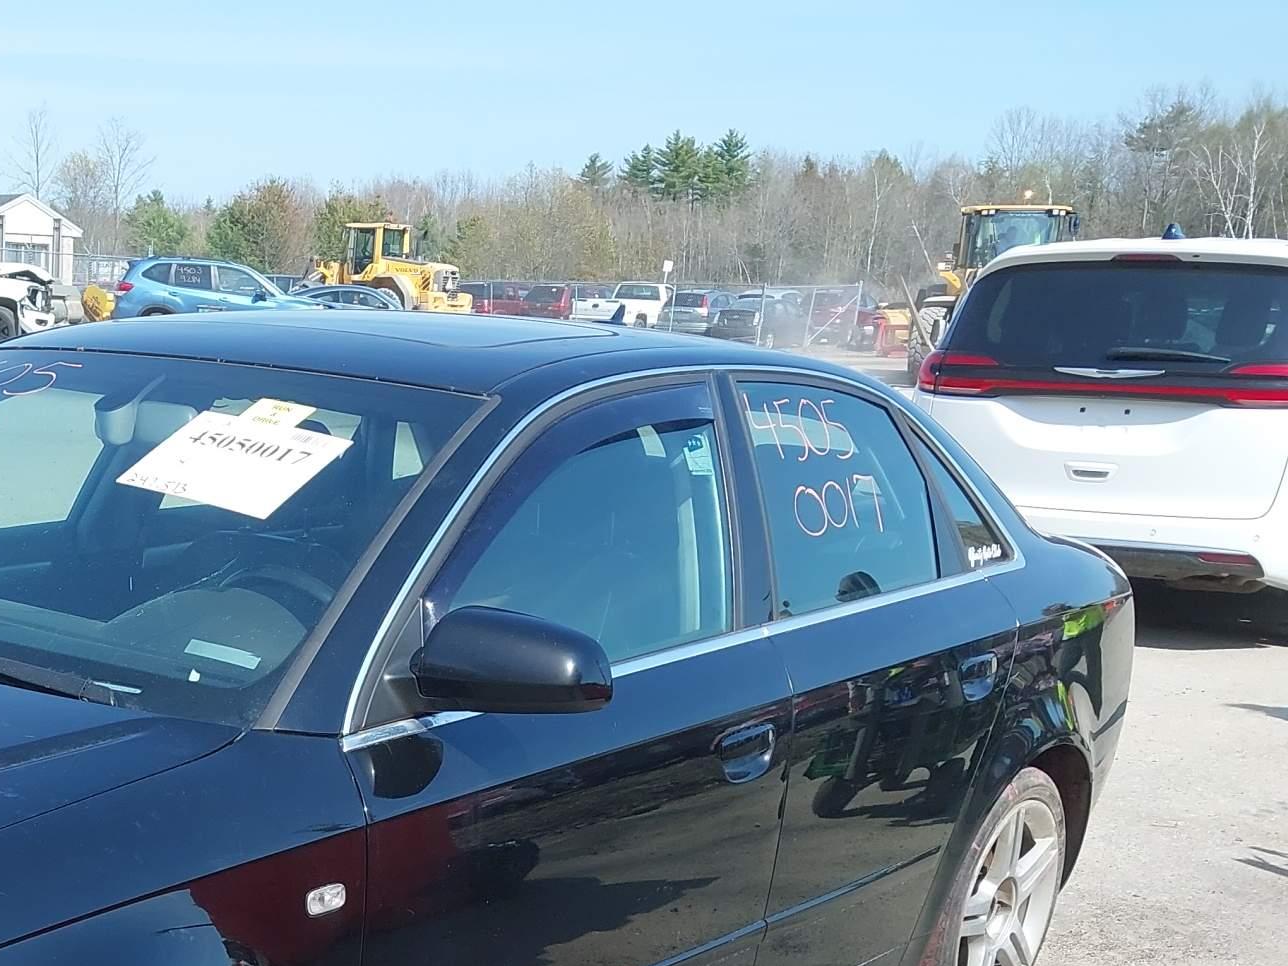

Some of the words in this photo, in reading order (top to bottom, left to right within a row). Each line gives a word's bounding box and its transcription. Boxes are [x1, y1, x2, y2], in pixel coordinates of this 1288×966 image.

[188, 430, 313, 464] 45050017
[743, 393, 854, 461] 4505
[794, 474, 884, 536] 0017
